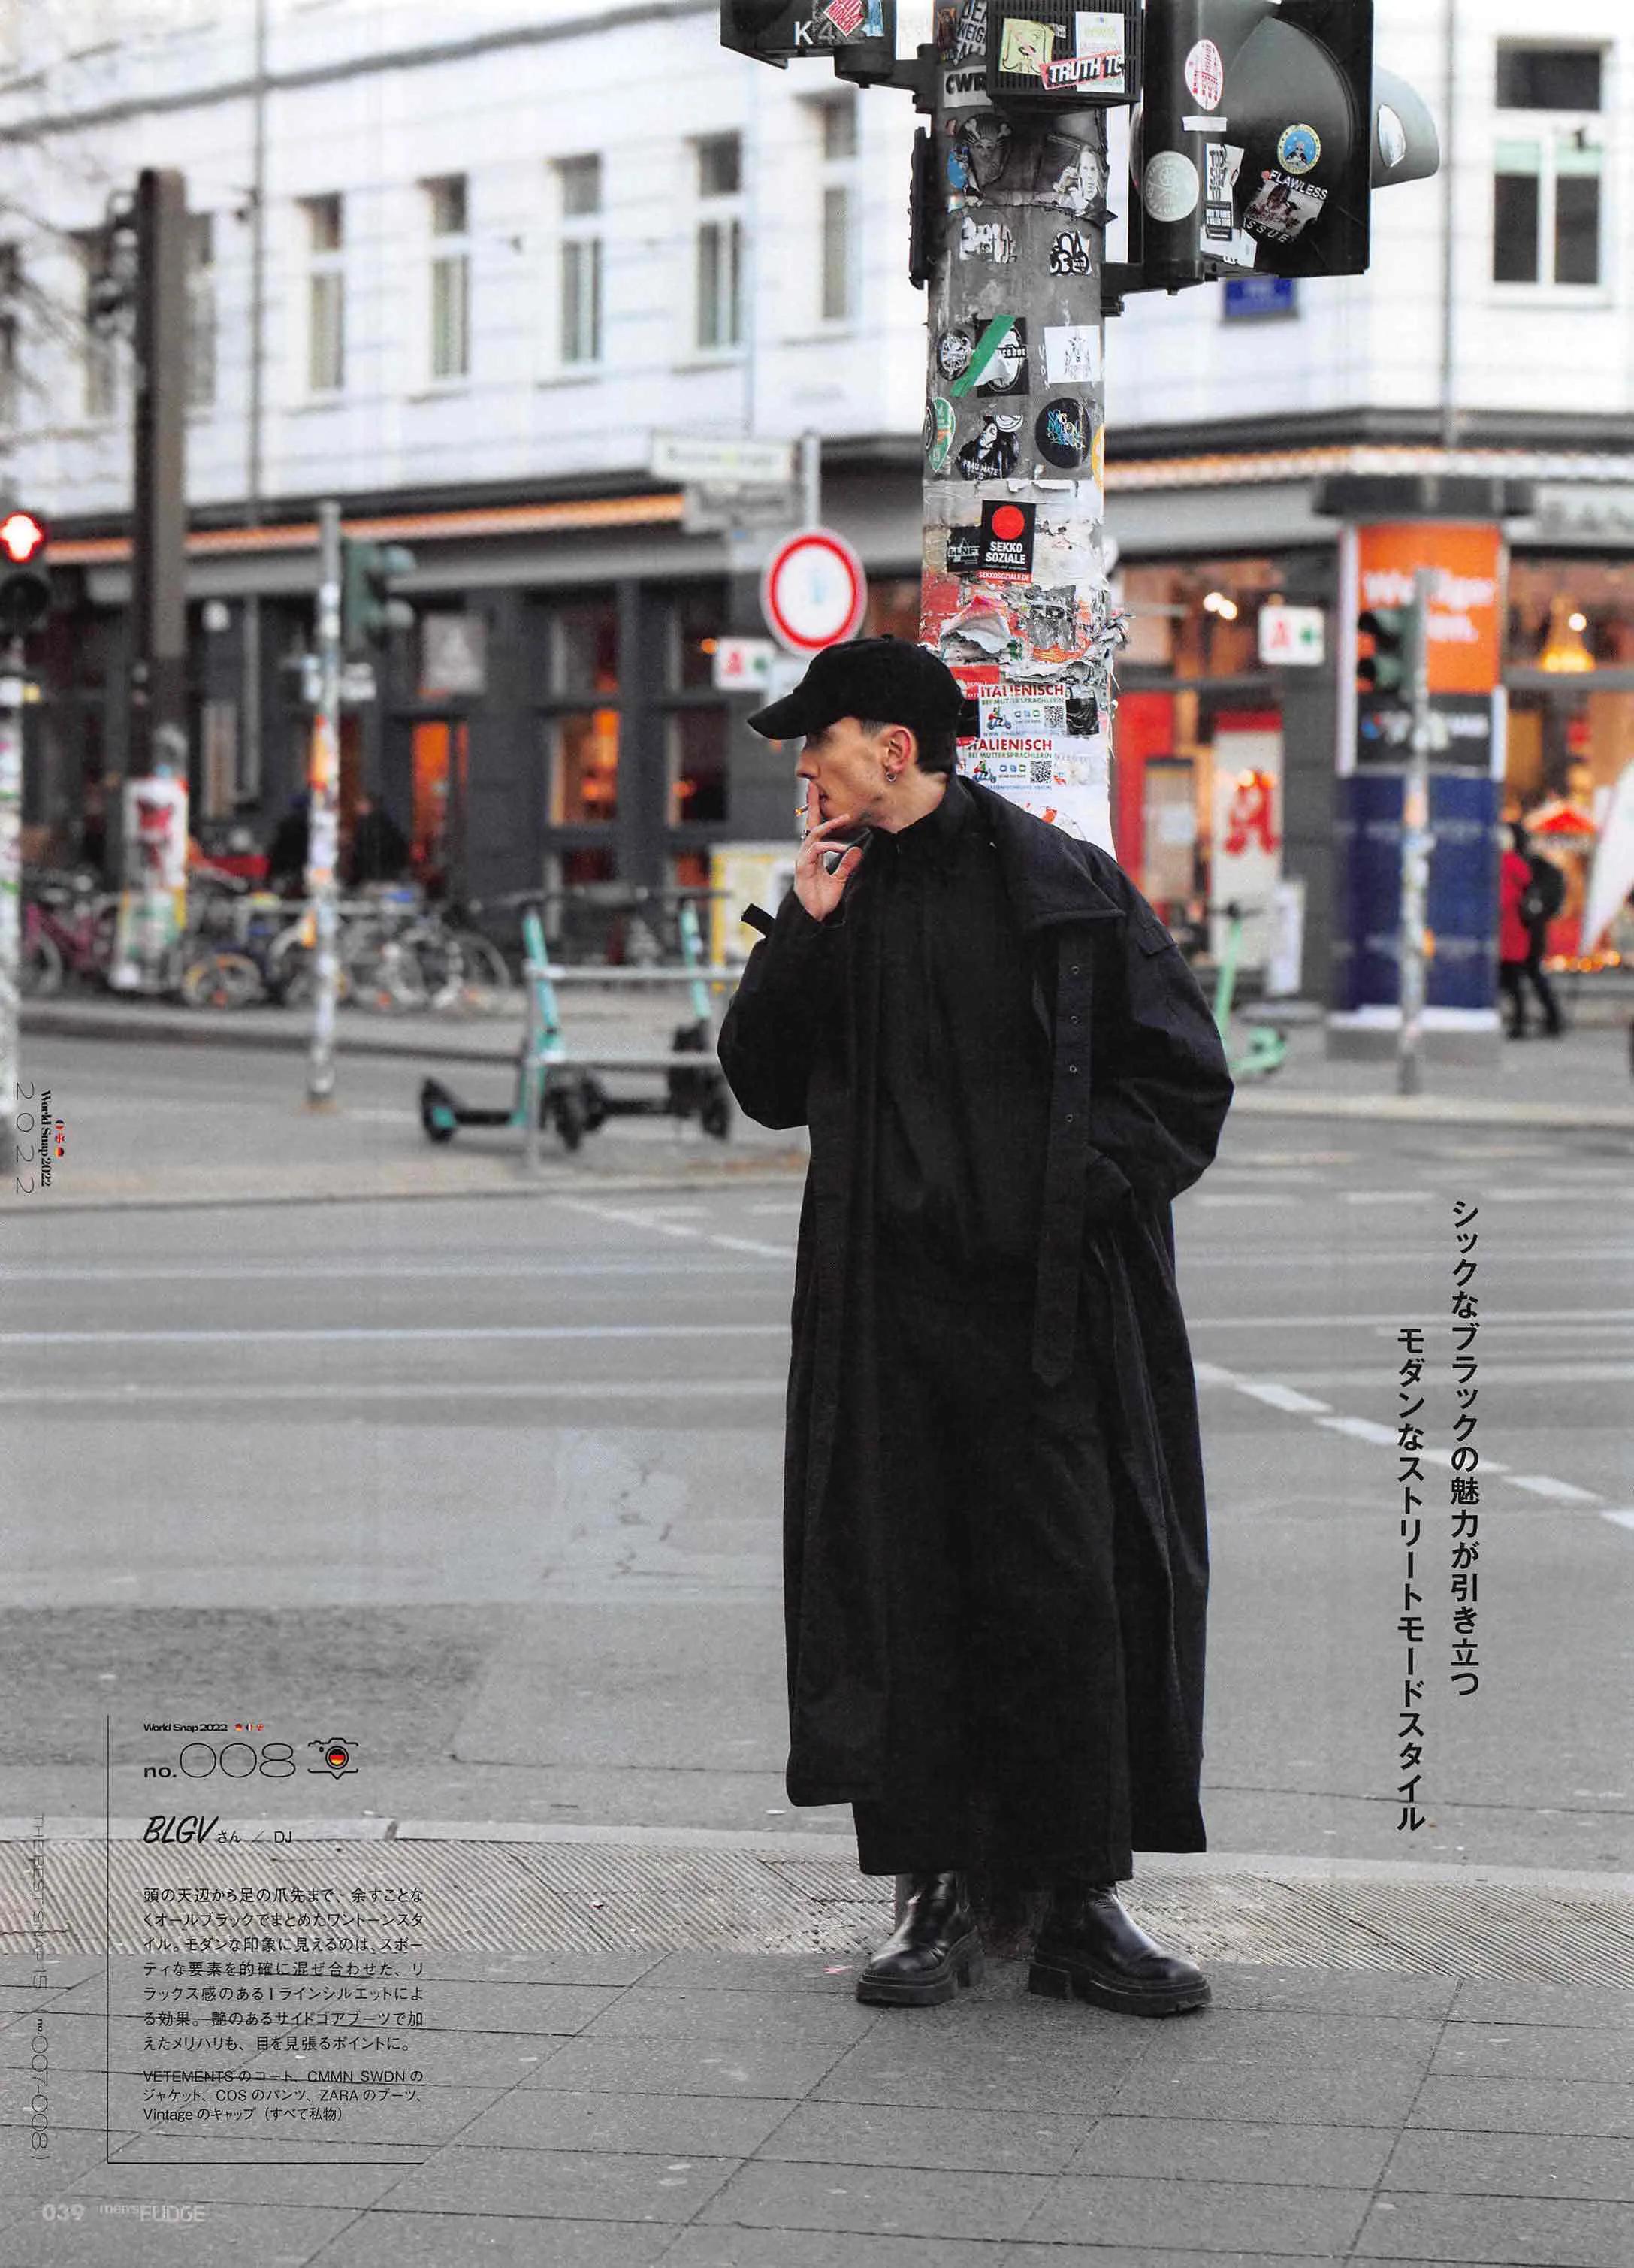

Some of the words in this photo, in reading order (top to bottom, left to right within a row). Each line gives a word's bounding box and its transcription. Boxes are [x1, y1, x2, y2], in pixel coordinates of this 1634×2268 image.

[1049, 57, 1101, 84] TRUTH
[1268, 169, 1328, 201] FLAWLESS
[989, 541, 1022, 553] SEKKO
[985, 552, 1026, 564] SOZIALE
